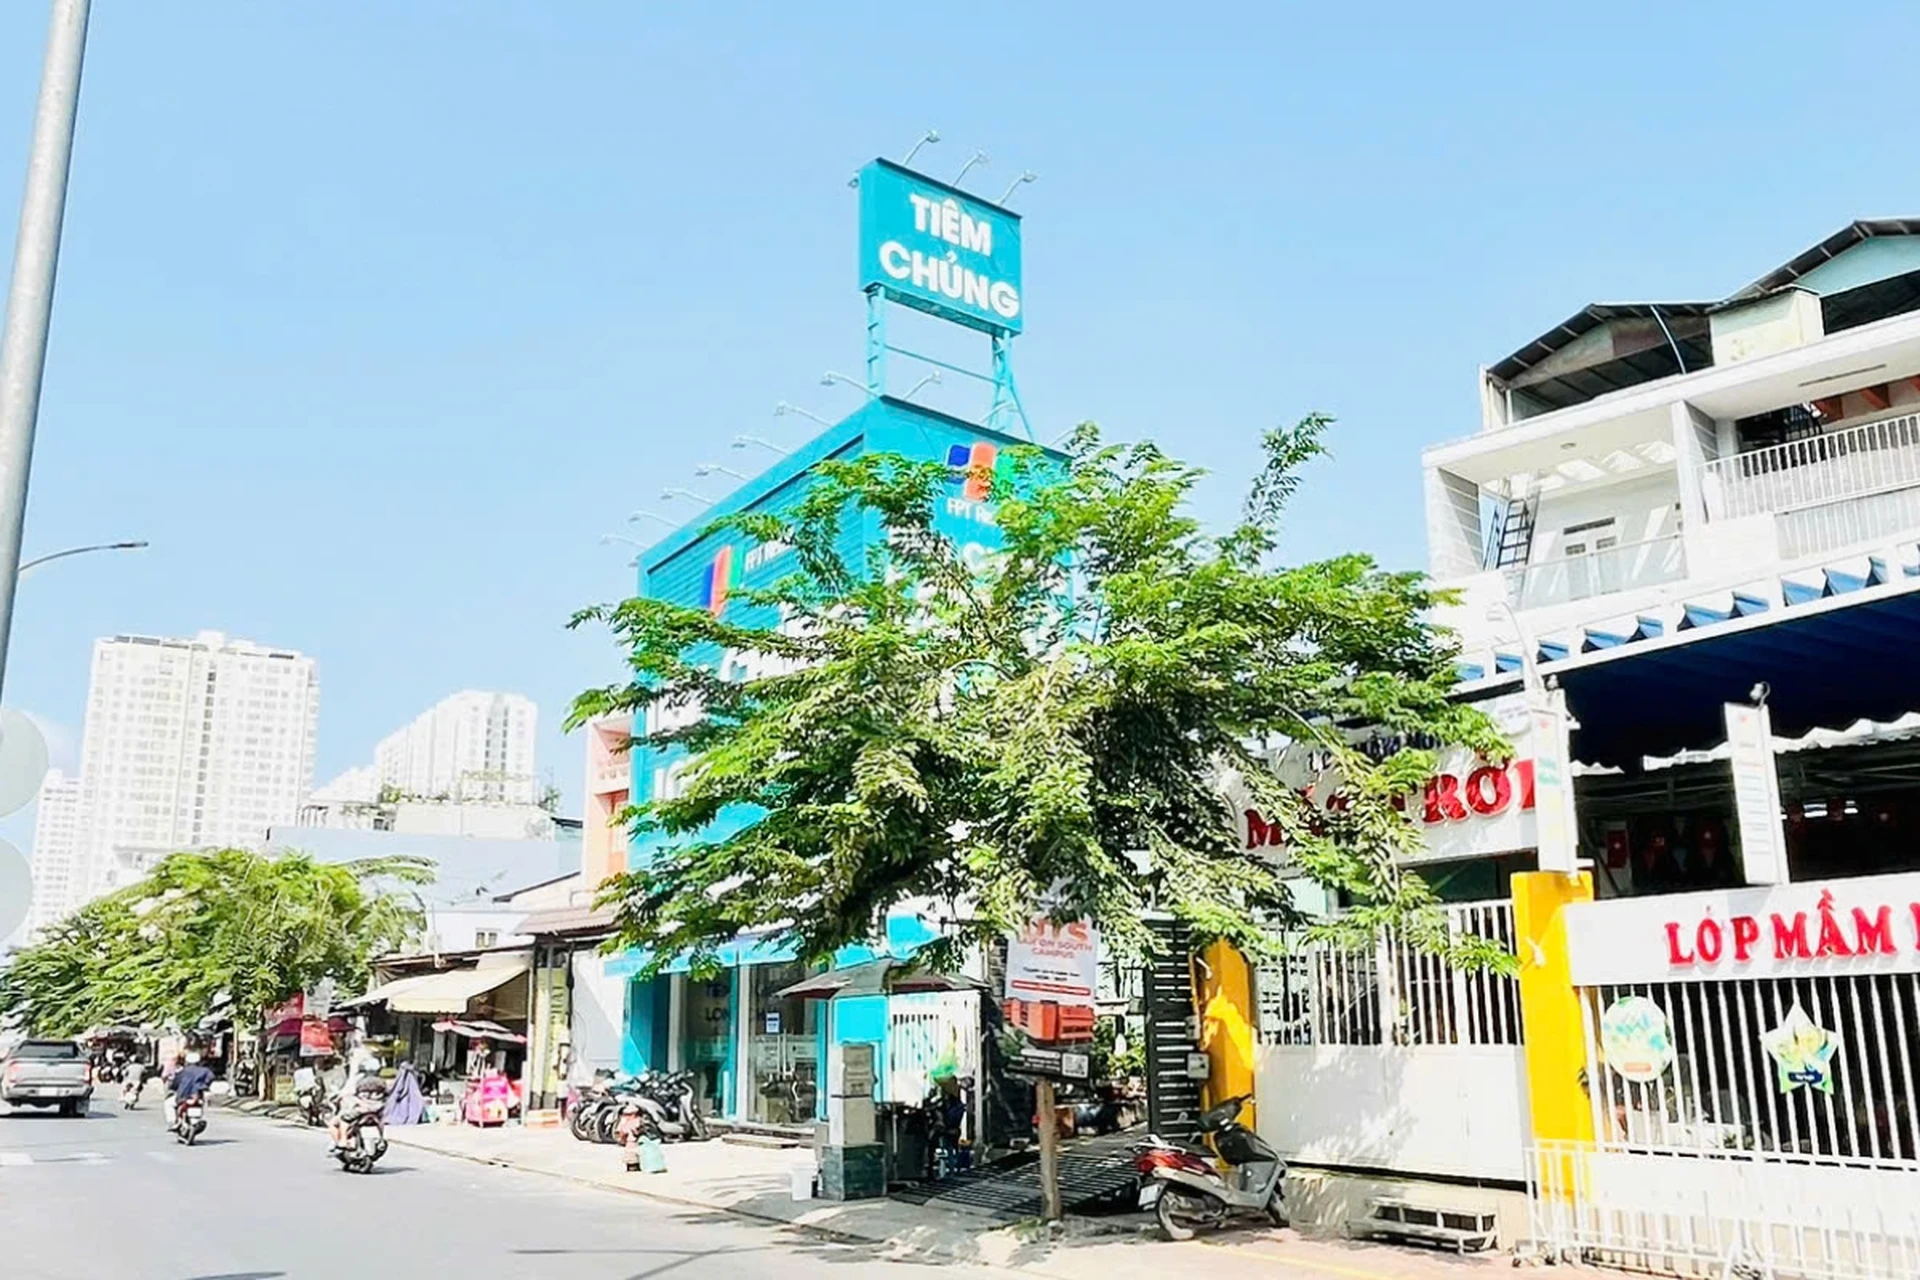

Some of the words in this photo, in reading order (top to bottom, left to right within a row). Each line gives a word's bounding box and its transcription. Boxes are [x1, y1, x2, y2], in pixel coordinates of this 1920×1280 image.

[910, 193, 992, 256] TIÊM
[879, 241, 1019, 318] CHỦNG
[947, 498, 970, 519] FPT
